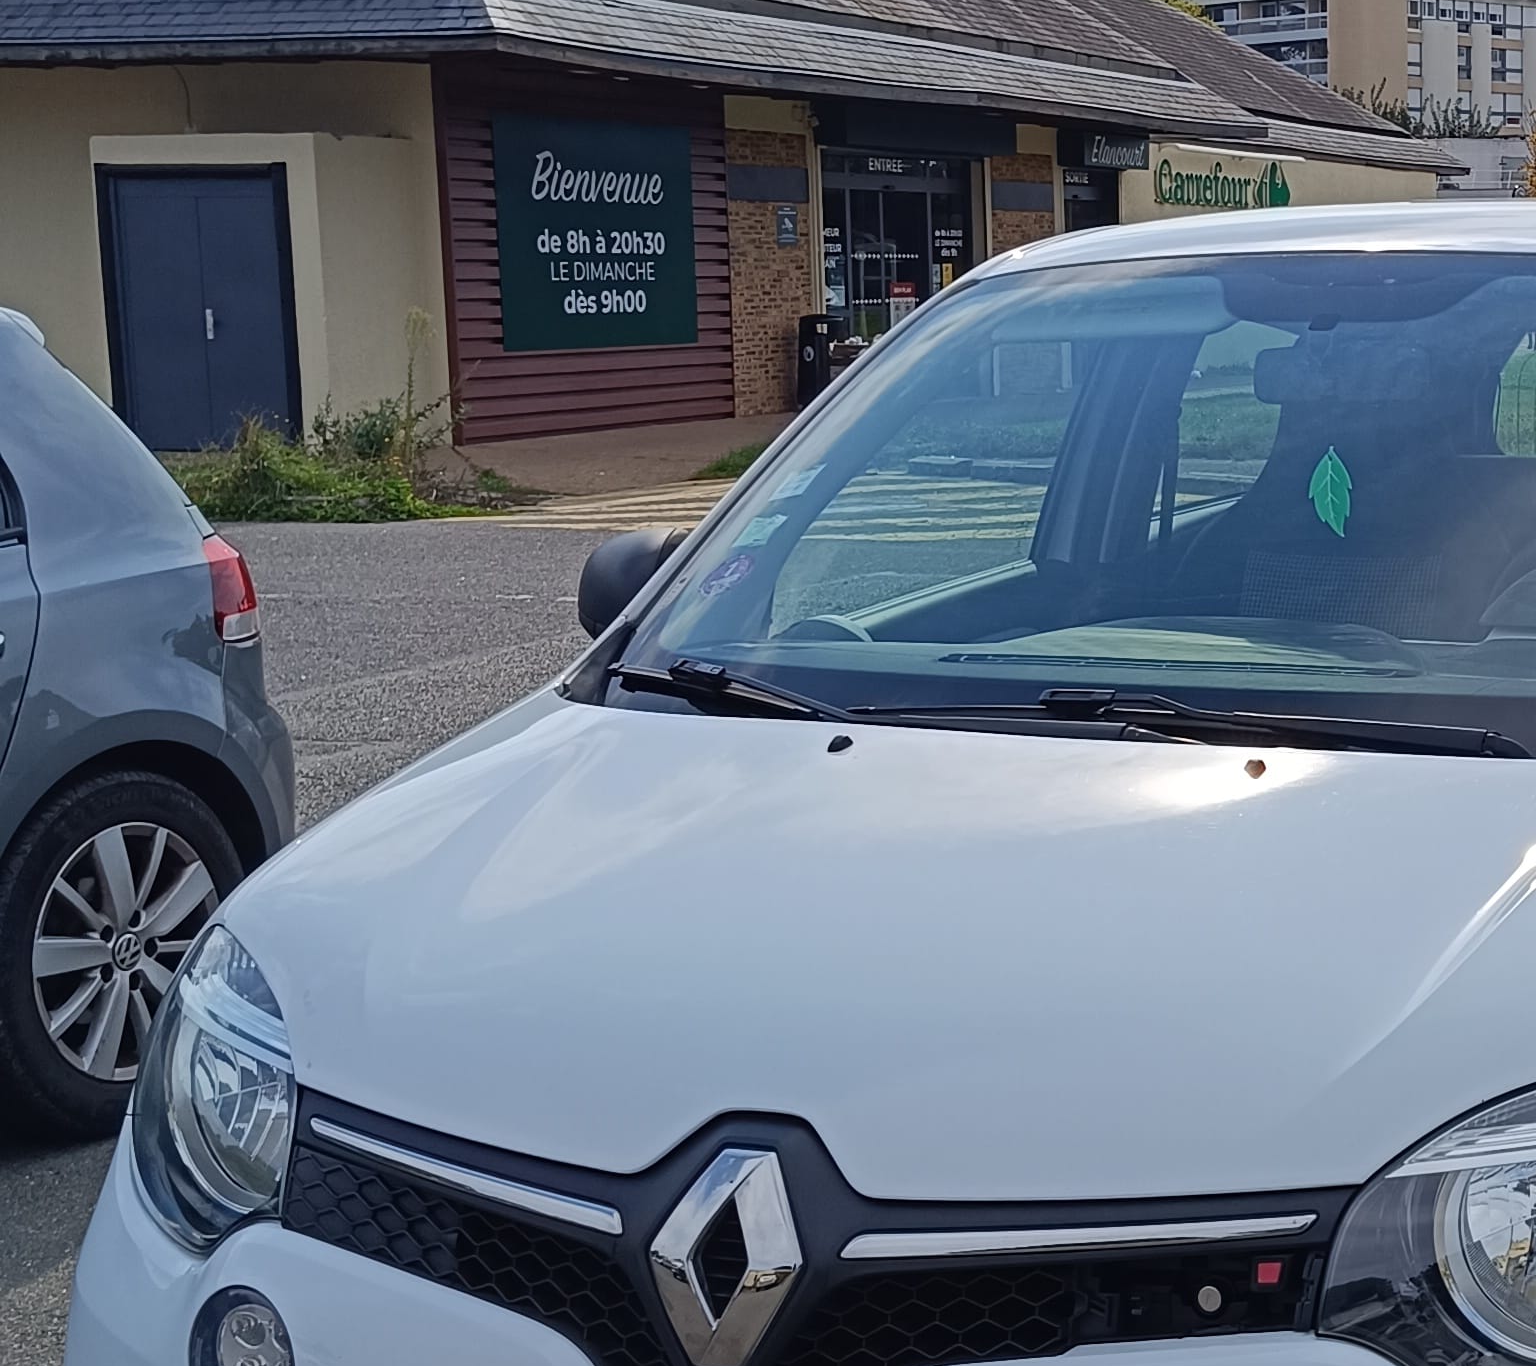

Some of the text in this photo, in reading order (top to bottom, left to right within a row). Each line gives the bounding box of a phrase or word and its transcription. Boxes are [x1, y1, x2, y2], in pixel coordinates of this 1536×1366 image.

[531, 150, 664, 204] Bienvenue
[1064, 171, 1089, 184] SORTIE
[1156, 159, 1251, 207] Carrefour
[537, 228, 665, 255] de 8h à 20h30
[550, 261, 655, 281] LE DIMANCHE
[564, 289, 647, 314] dès 9h00
